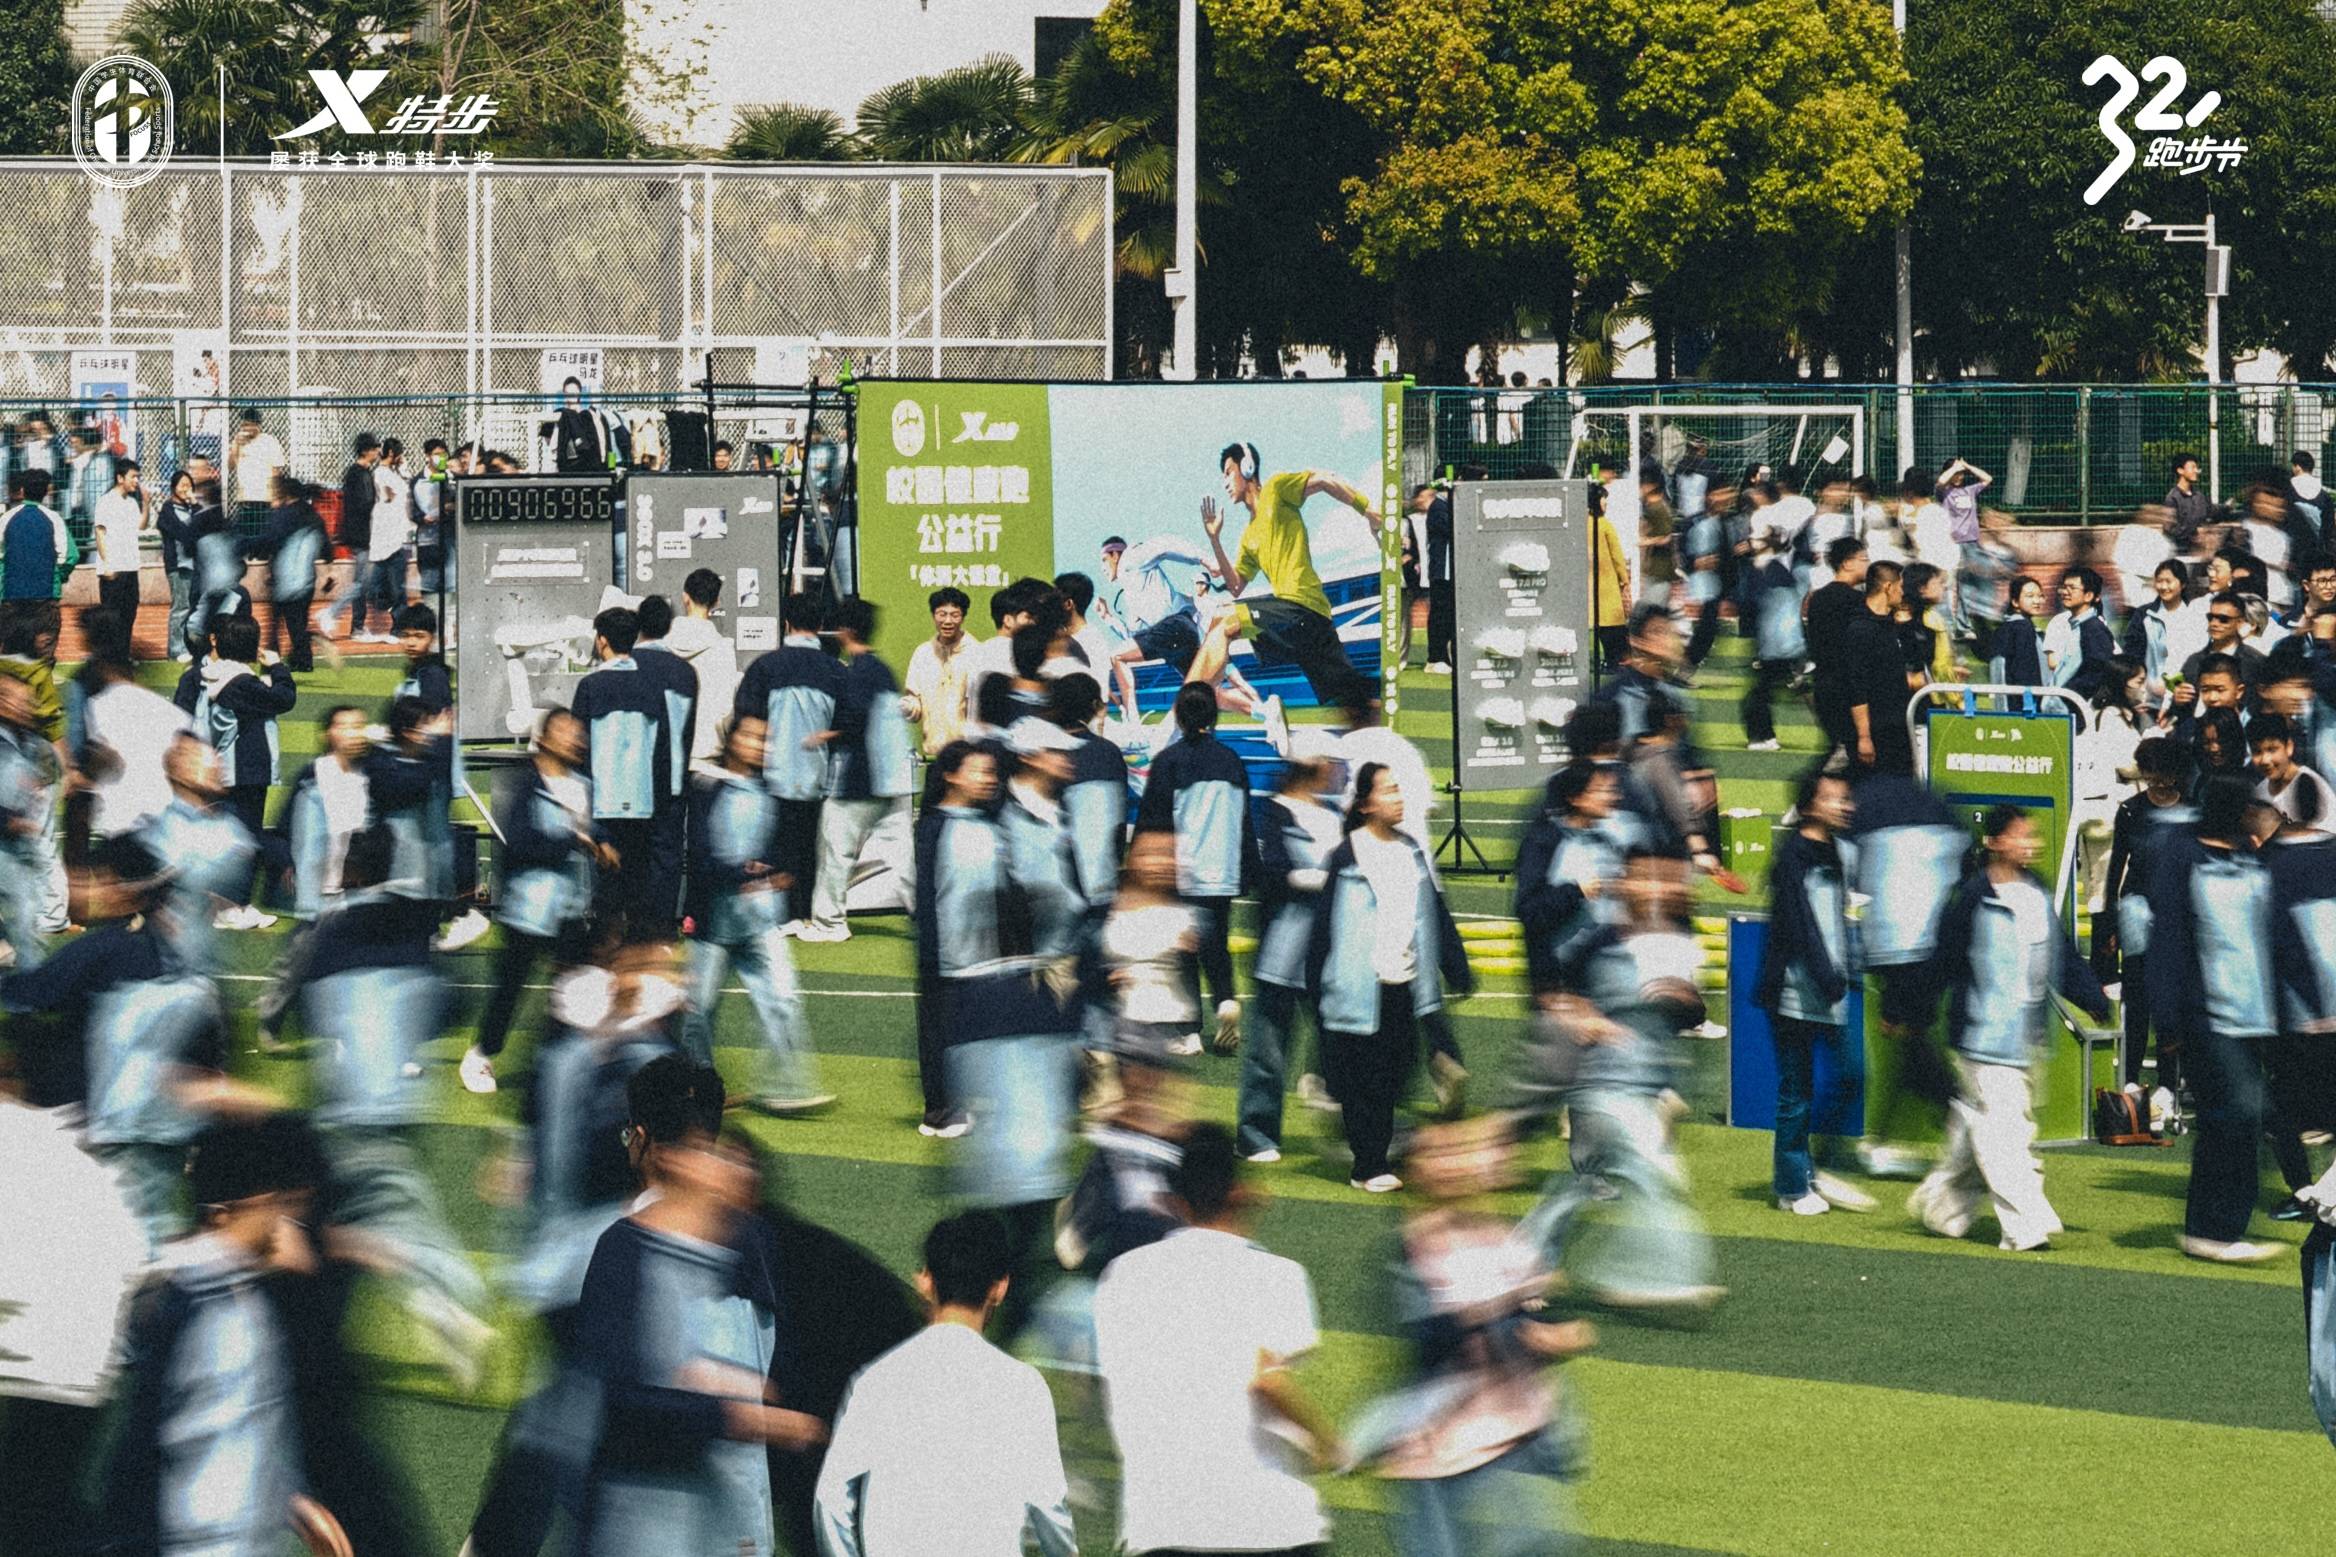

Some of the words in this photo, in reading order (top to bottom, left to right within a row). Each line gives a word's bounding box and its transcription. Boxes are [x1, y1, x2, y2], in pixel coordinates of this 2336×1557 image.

[471, 487, 612, 521] 00906966
[916, 513, 1002, 553] 公益行
